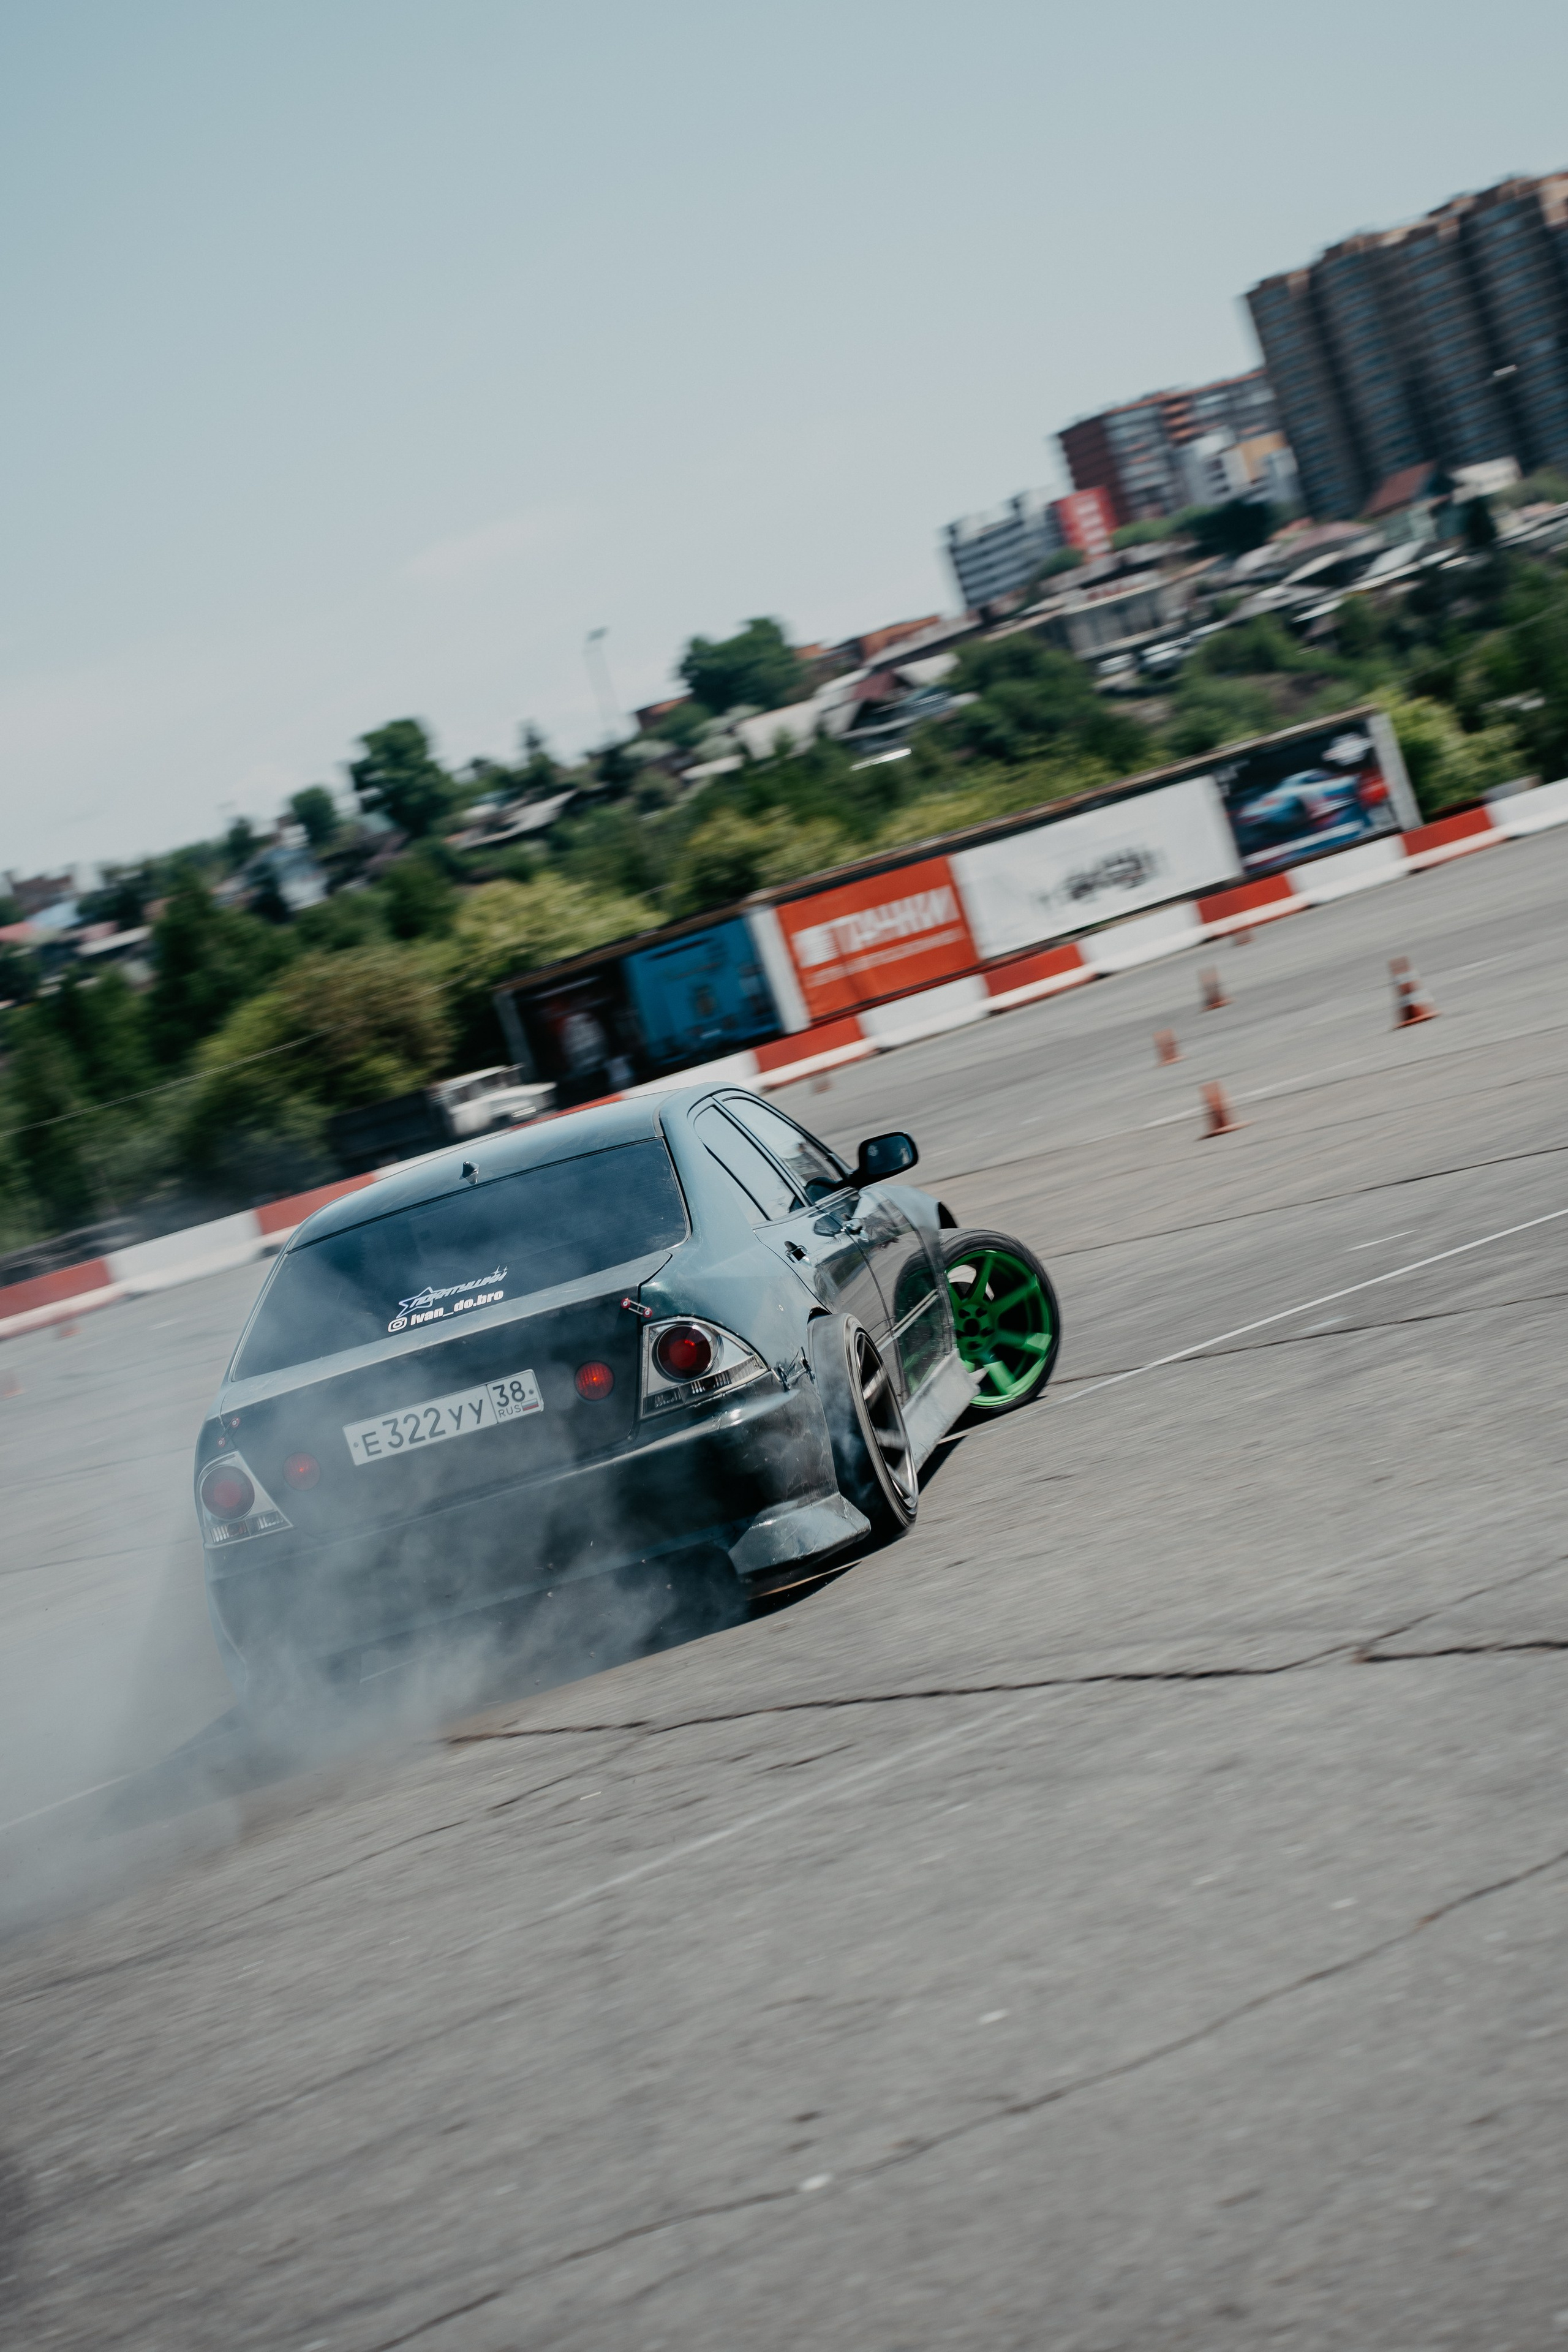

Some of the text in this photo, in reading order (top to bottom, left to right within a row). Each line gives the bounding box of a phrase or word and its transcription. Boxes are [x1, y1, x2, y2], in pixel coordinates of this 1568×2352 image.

[410, 1291, 504, 1325] ivan_do.bro
[492, 1381, 526, 1408] 38
[498, 1404, 522, 1418] RUS
